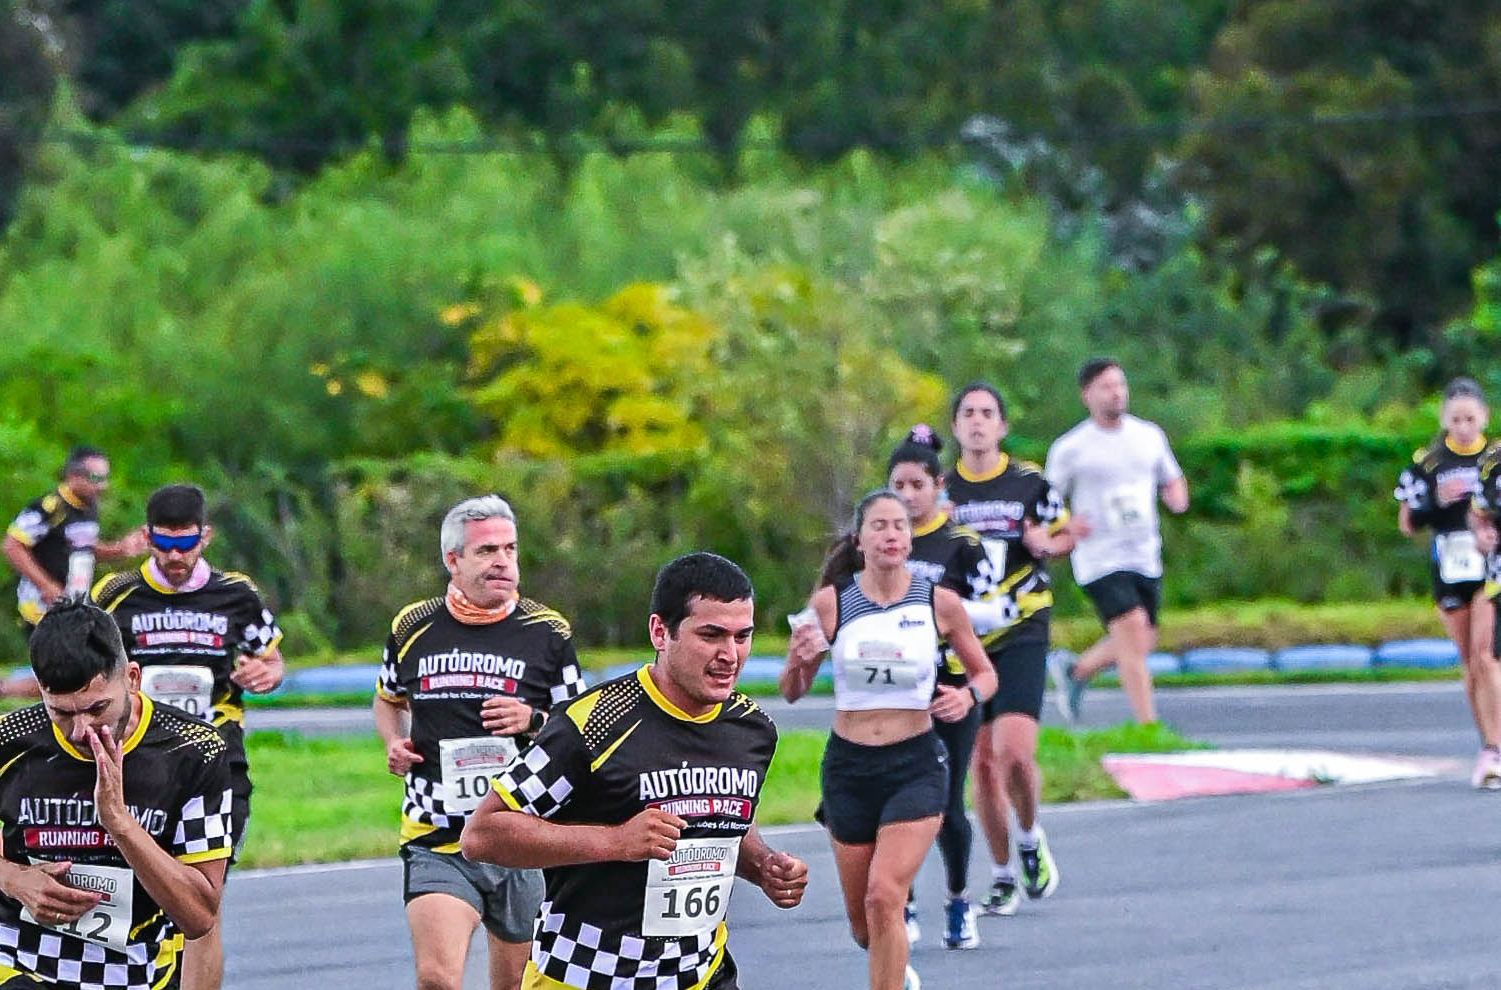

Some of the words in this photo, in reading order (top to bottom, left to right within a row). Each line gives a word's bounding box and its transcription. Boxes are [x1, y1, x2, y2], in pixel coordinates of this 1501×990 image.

[417, 648, 526, 680] AUTÓDROMO
[476, 675, 505, 691] RACE
[864, 667, 896, 685] 71
[455, 775, 489, 799] 10
[639, 761, 758, 801] AUTÓDROMO
[713, 799, 743, 816] RACE
[39, 831, 99, 847] RUNNING
[661, 885, 720, 919] 166
